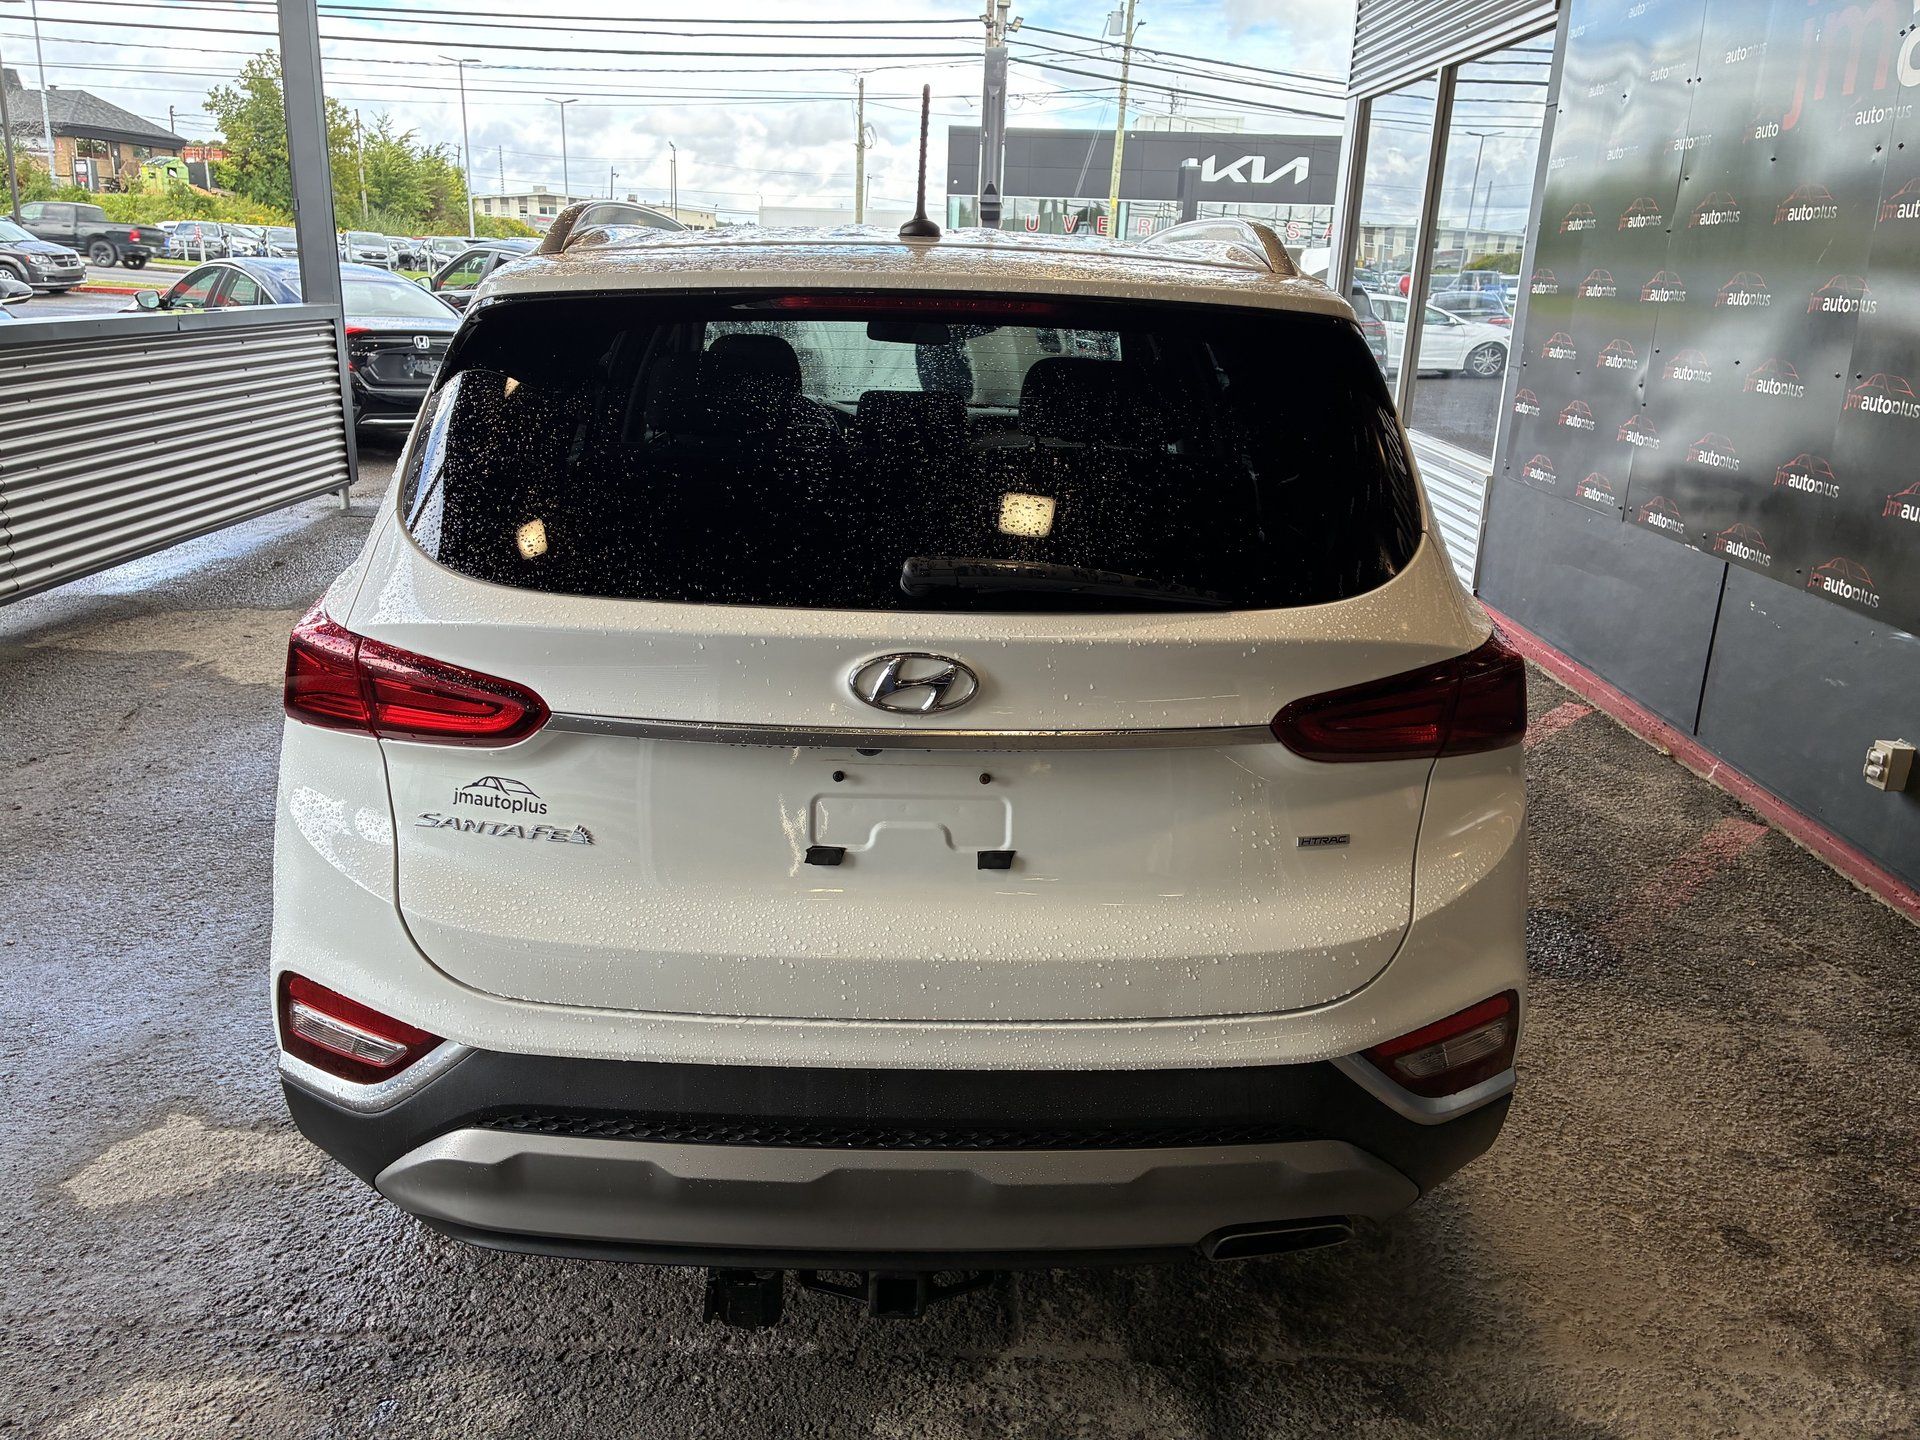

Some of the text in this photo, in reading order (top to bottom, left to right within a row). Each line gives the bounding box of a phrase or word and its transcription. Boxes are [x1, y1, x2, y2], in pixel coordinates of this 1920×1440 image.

[980, 213, 1152, 237] UVER
[1773, 203, 1837, 225] jmautoplus
[1714, 289, 1771, 308] jmautoplus
[1807, 292, 1877, 314] jmautoplus
[1743, 373, 1805, 398] jmautoplus
[1843, 389, 1920, 419] jmautoplus
[1773, 466, 1840, 500] jmautoplus
[1713, 532, 1772, 568] jmautoplus
[1807, 566, 1880, 609] jmautoplus
[452, 787, 548, 816] jmautoplus
[1300, 835, 1347, 846] HTRAC
